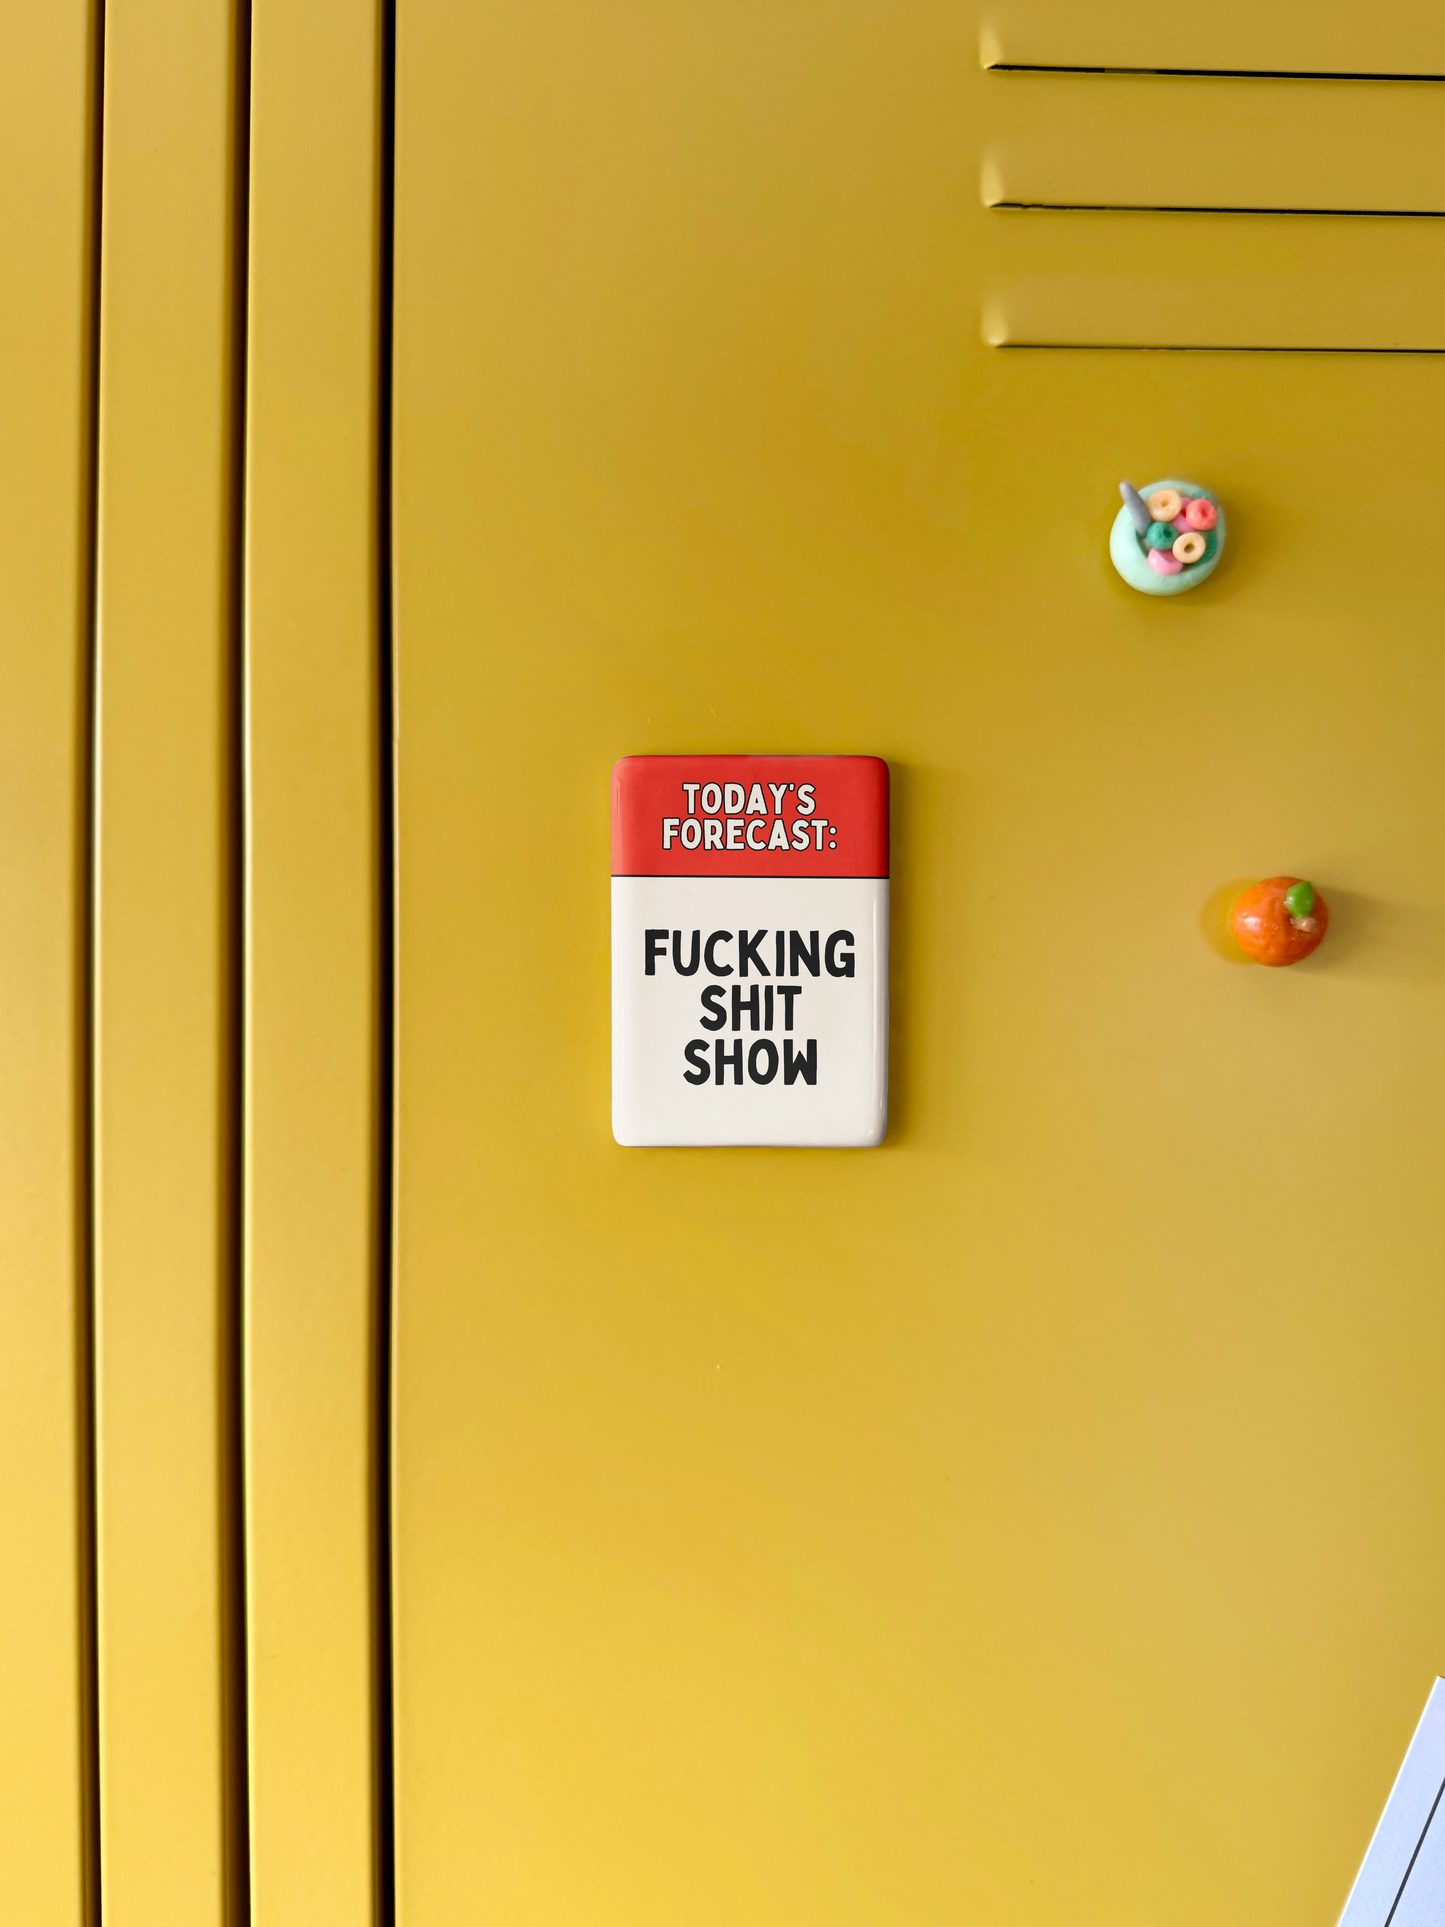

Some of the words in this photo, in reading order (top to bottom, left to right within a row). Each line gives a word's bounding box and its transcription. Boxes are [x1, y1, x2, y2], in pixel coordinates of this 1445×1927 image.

[682, 782, 816, 815] TODAY'S
[662, 817, 838, 851] FORECAST:
[644, 928, 856, 978] FUCKING
[699, 984, 802, 1032] SHIT
[682, 1038, 818, 1086] SHOW
